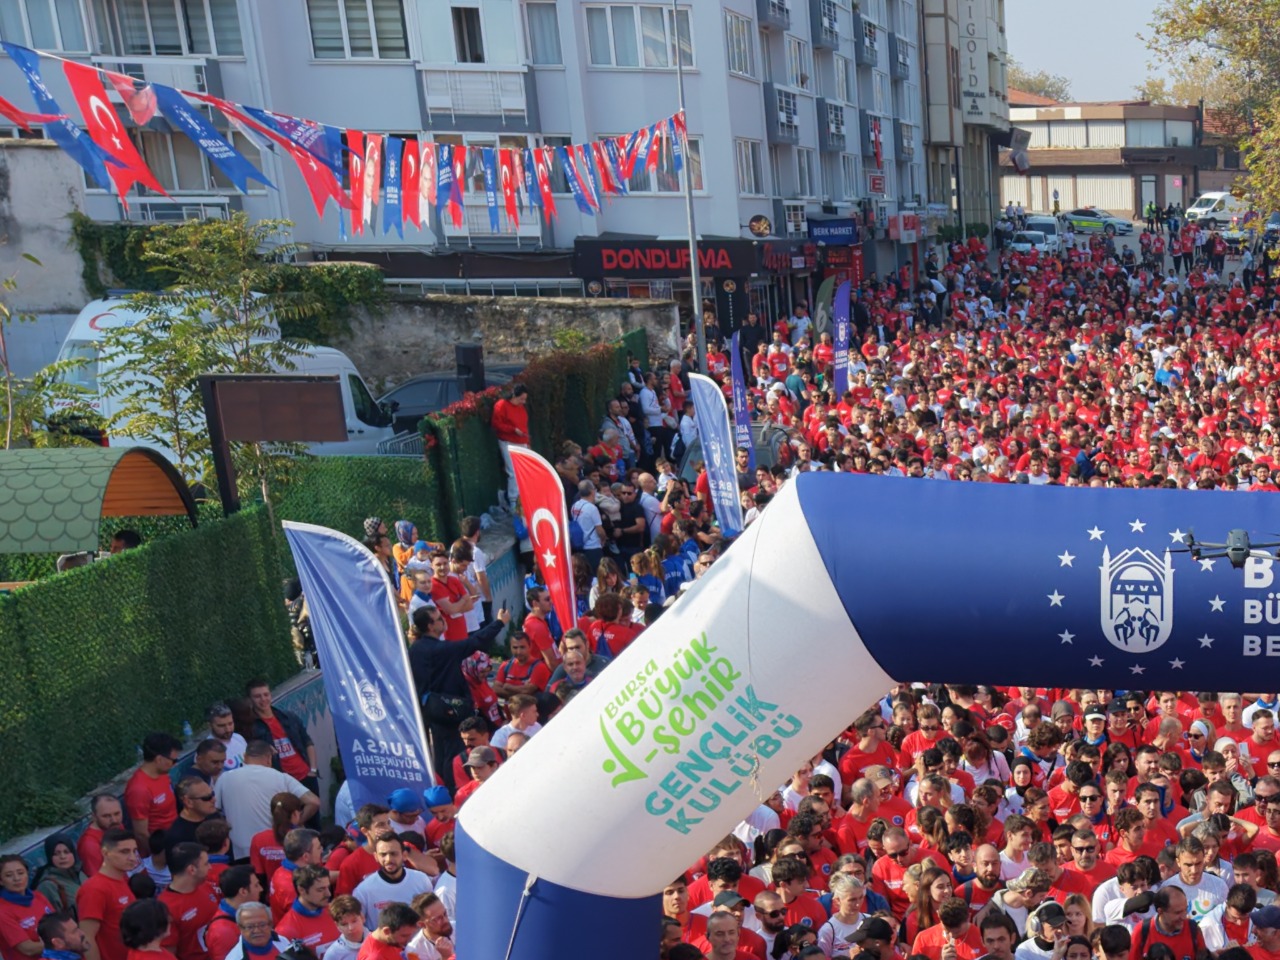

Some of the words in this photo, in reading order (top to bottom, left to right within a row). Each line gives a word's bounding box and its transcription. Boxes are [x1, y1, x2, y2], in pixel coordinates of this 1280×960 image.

[813, 228, 829, 236] BERK
[830, 227, 853, 235] MARKET
[665, 713, 803, 835] KULÜBÜ
